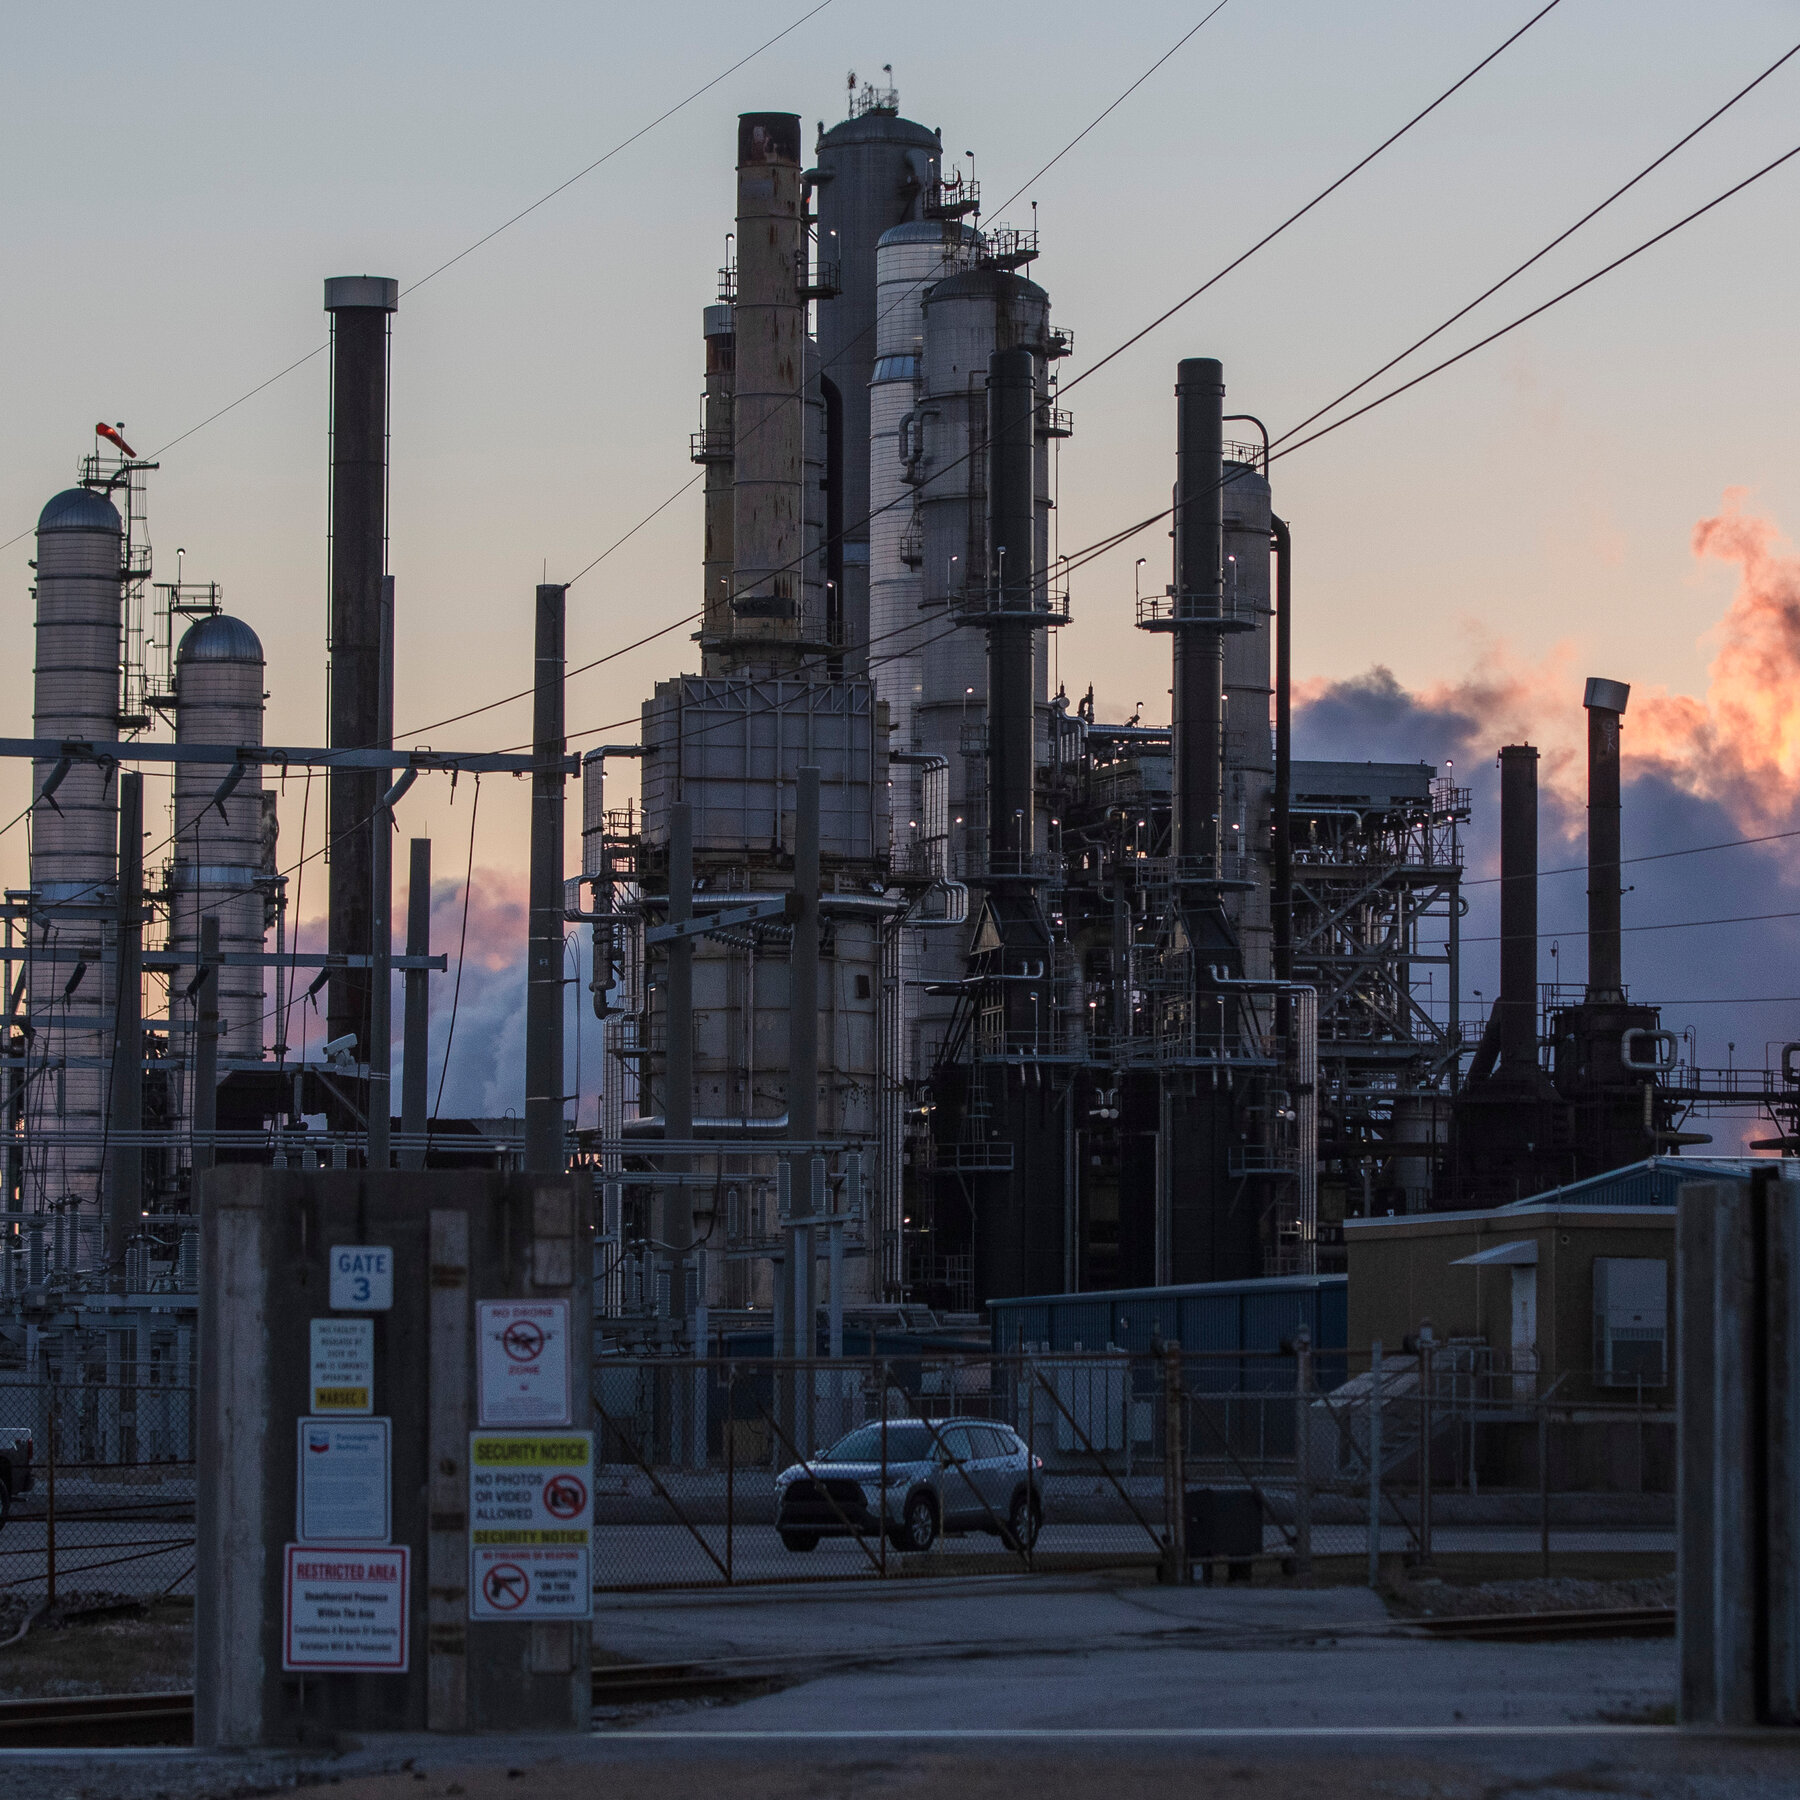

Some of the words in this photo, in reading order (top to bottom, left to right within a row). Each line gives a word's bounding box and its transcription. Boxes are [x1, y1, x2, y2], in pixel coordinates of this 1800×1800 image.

[338, 1254, 387, 1274] GATE
[352, 1278, 371, 1302] 3
[509, 1366, 540, 1376] ZONE
[319, 1391, 357, 1405] MARSEC
[477, 1444, 537, 1460] SECURITY
[540, 1444, 585, 1460] NOTICE
[475, 1474, 493, 1486] NO
[495, 1474, 544, 1486] PHOTOS
[475, 1491, 494, 1503] OR
[495, 1491, 532, 1503] VIDEO
[476, 1508, 533, 1520] ALLOWED
[474, 1531, 537, 1543] SECURITY
[540, 1531, 586, 1543] NOTICE
[298, 1564, 364, 1580] RESTRICTED
[369, 1565, 397, 1580] AREA
[318, 1609, 340, 1618] Within
